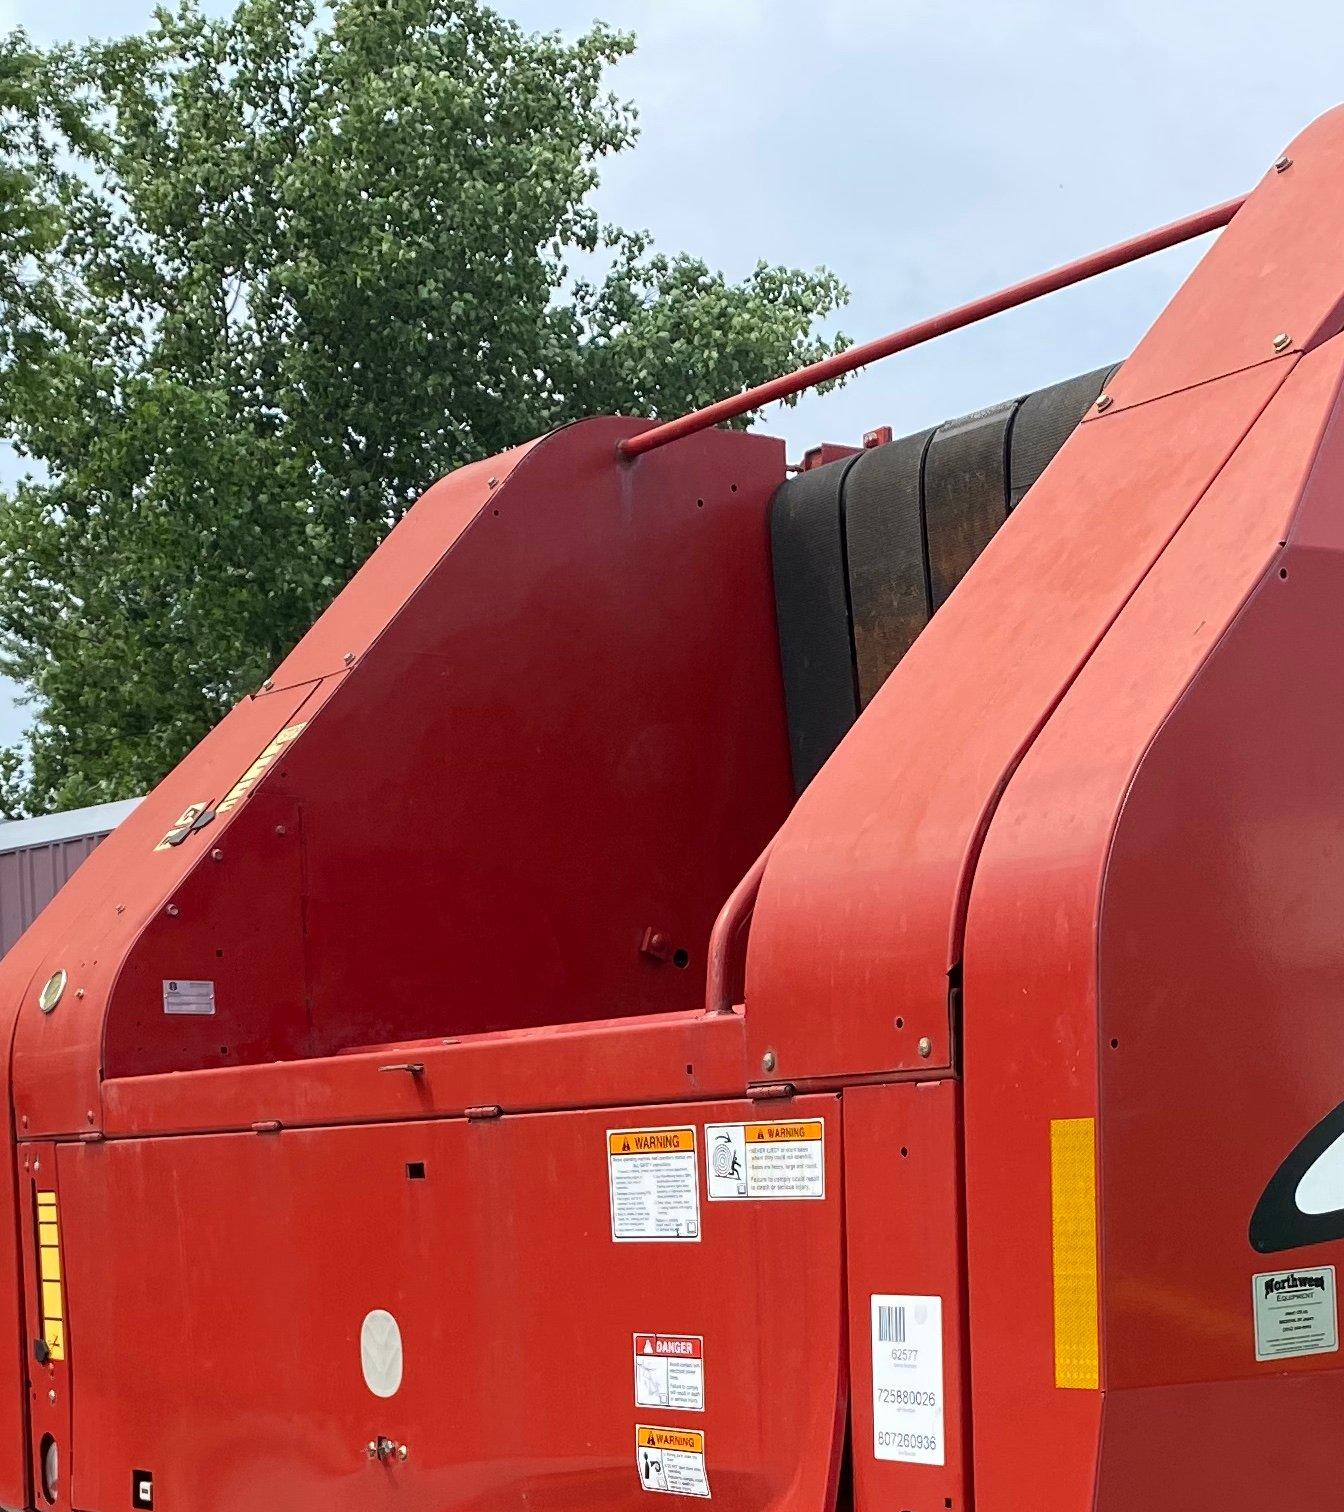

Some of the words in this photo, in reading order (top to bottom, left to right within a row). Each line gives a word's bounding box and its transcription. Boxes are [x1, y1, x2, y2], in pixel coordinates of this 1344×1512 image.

[767, 1126, 805, 1139] WARNING
[634, 1134, 680, 1150] WARNING
[656, 1340, 693, 1355] DANGER
[891, 1348, 918, 1362] 62577
[877, 1388, 936, 1407] 725880026
[655, 1433, 695, 1448] WARNING
